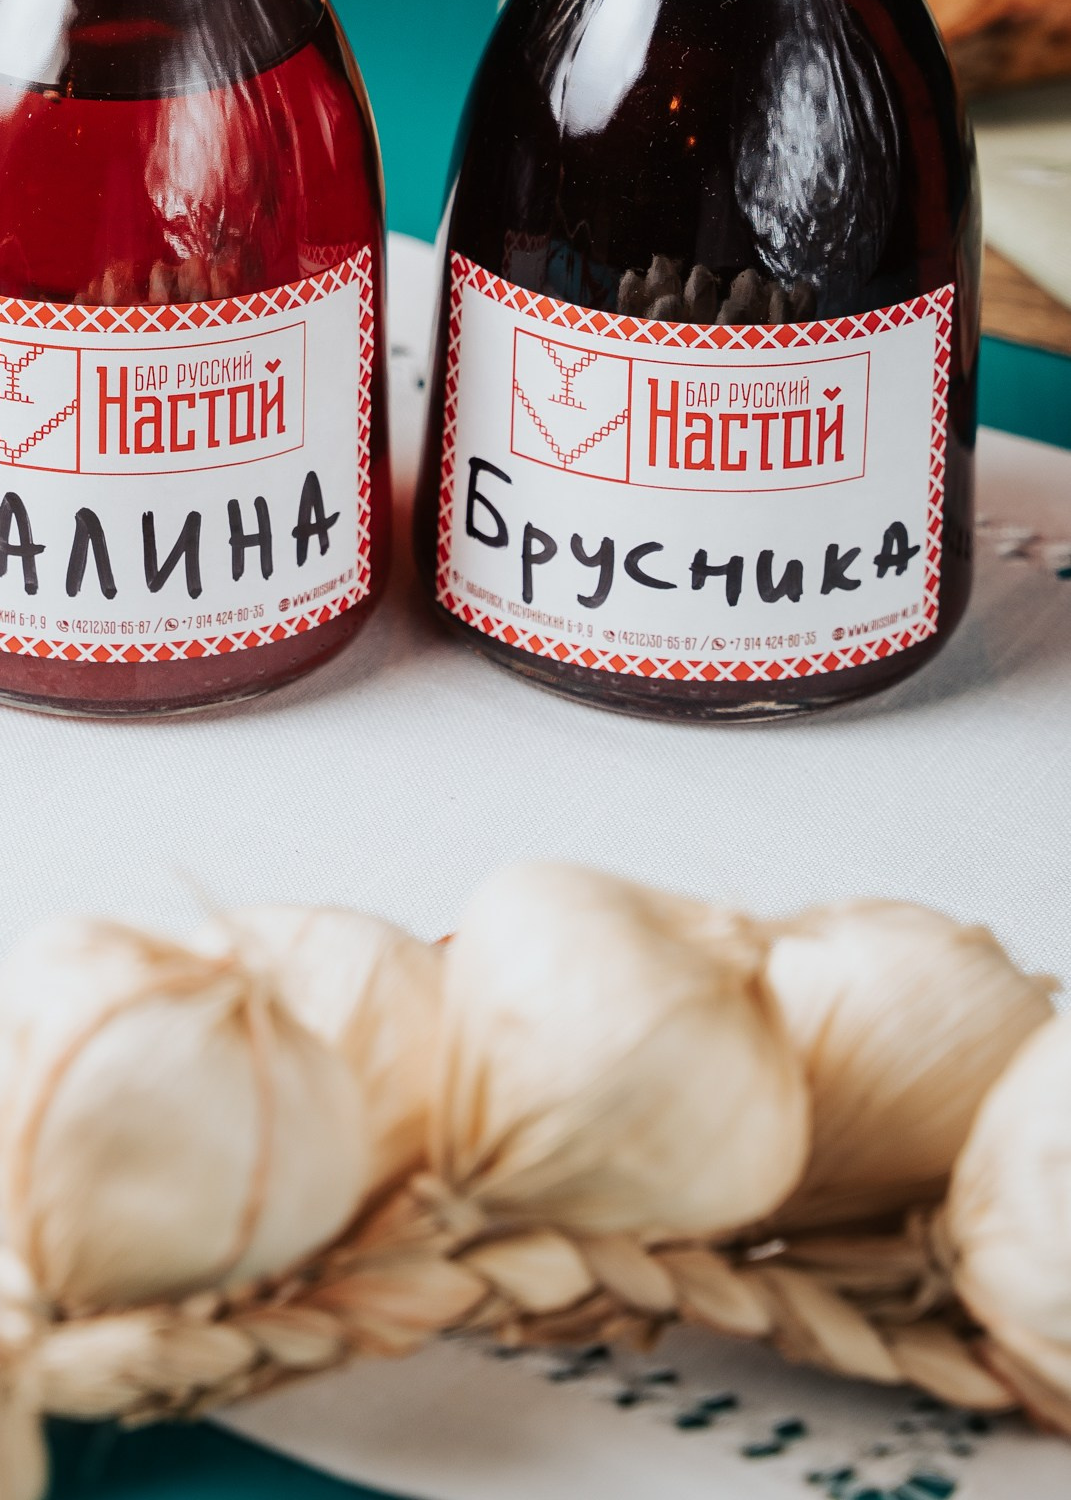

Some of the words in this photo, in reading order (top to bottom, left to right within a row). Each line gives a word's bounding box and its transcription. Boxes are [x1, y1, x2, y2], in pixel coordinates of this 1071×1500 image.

[134, 366, 168, 391] БАР
[176, 350, 253, 387] РУССКИЙ
[685, 381, 720, 407] БАР
[728, 375, 810, 408] РУССКИЙ
[40, 616, 46, 629] 9
[72, 619, 151, 635] (4212)30-65-87
[182, 617, 192, 630] +7
[196, 614, 212, 629] 914
[216, 604, 264, 625] 424-80-35
[587, 624, 593, 637] 9
[618, 629, 697, 651] (4212)30-65-87
[730, 637, 740, 651] +7
[744, 637, 761, 650] 914
[765, 631, 816, 650] 424-80-35
